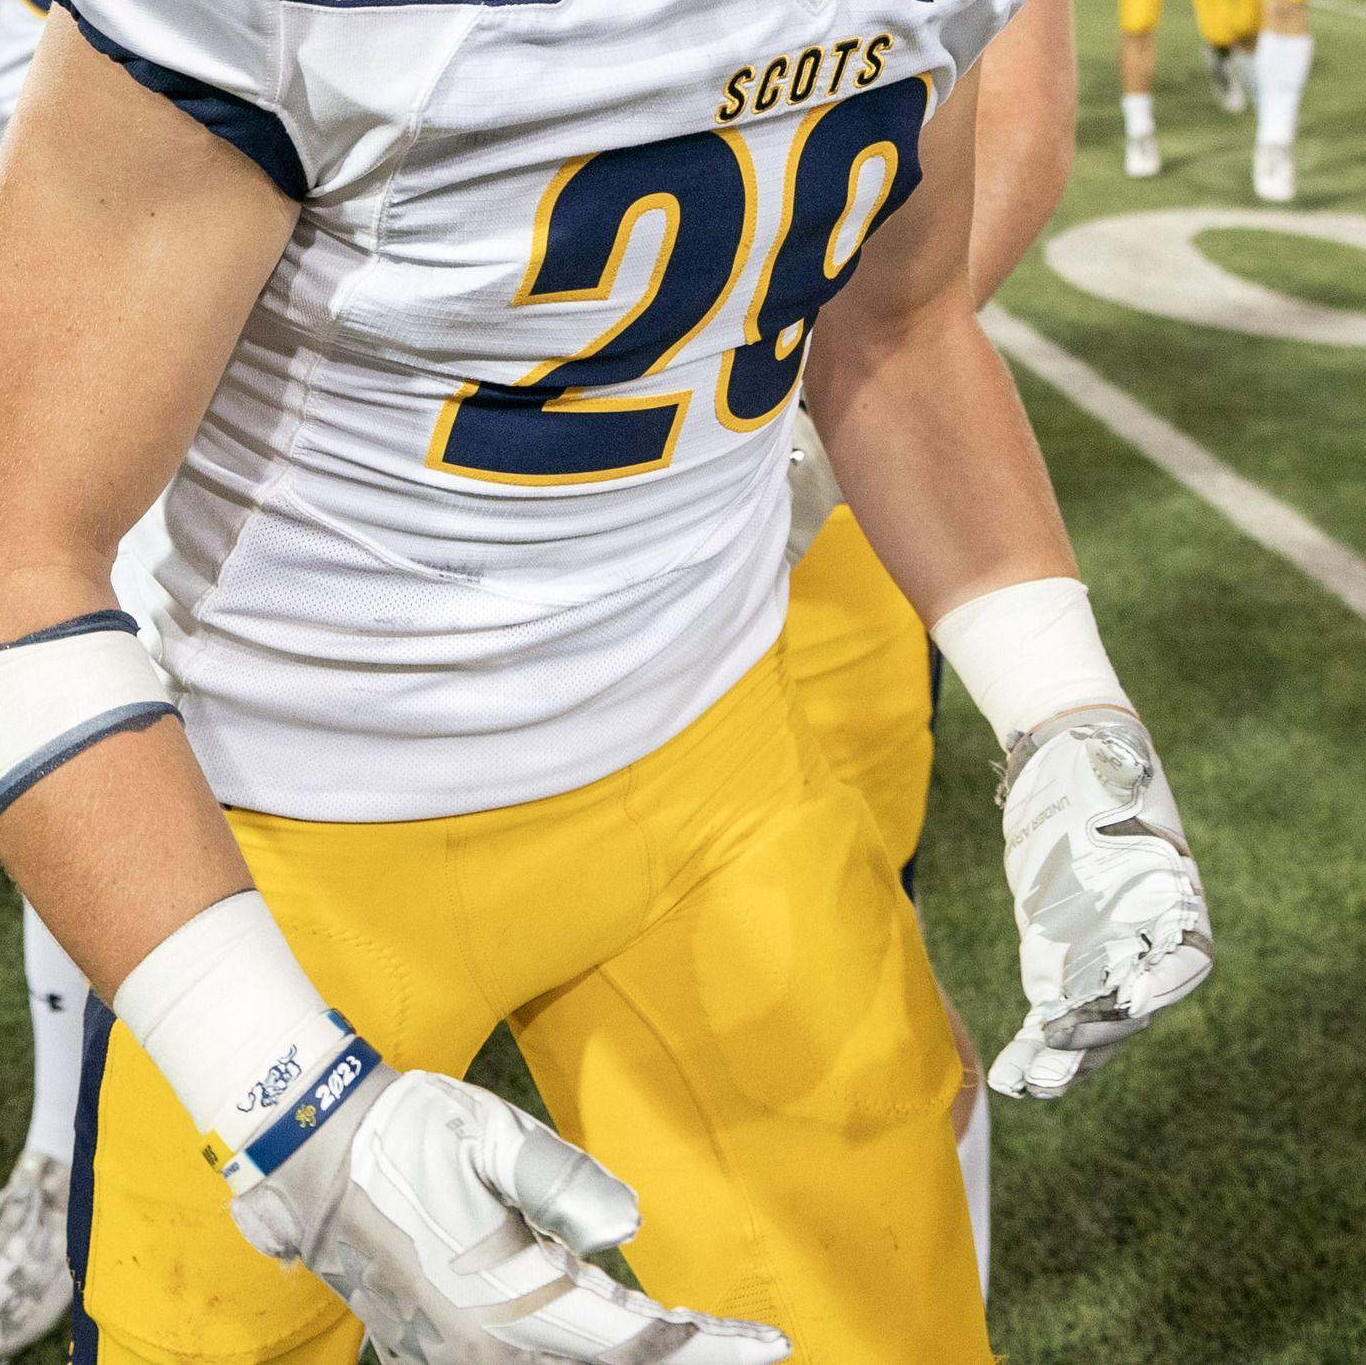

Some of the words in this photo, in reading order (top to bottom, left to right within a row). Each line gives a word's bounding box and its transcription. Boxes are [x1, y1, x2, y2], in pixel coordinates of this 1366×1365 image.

[714, 34, 895, 125] SCOTS
[424, 72, 933, 487] 29
[315, 1055, 362, 1111] 2023
